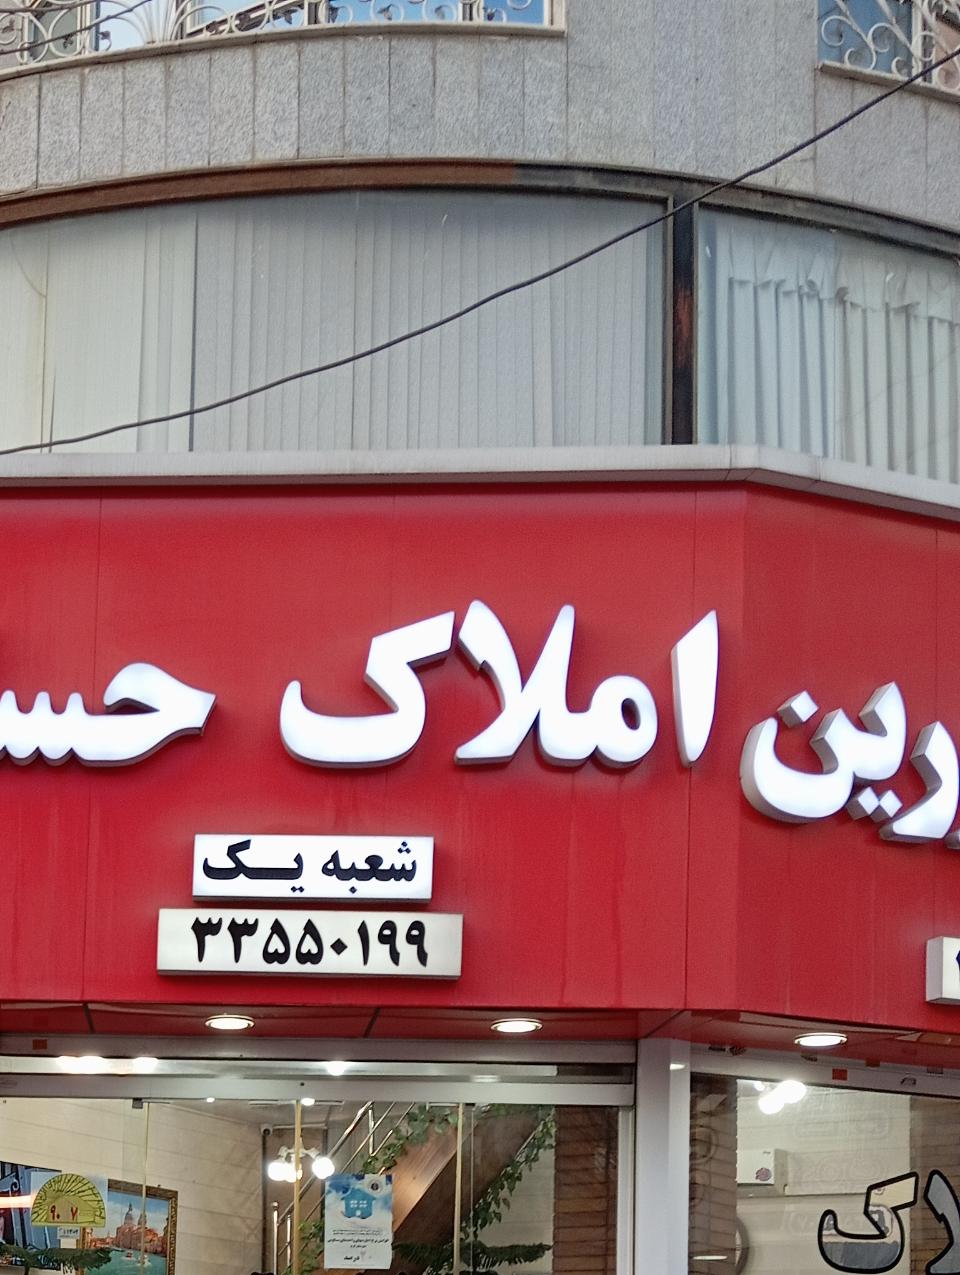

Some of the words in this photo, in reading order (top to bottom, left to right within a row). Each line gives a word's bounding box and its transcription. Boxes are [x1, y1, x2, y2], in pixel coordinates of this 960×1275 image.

[280, 600, 719, 768] املاک
[740, 681, 960, 848] رین
[202, 839, 305, 893] یک
[321, 841, 417, 894] شعبه
[191, 917, 428, 967] ۳۳۵۵۰۱۹۹
